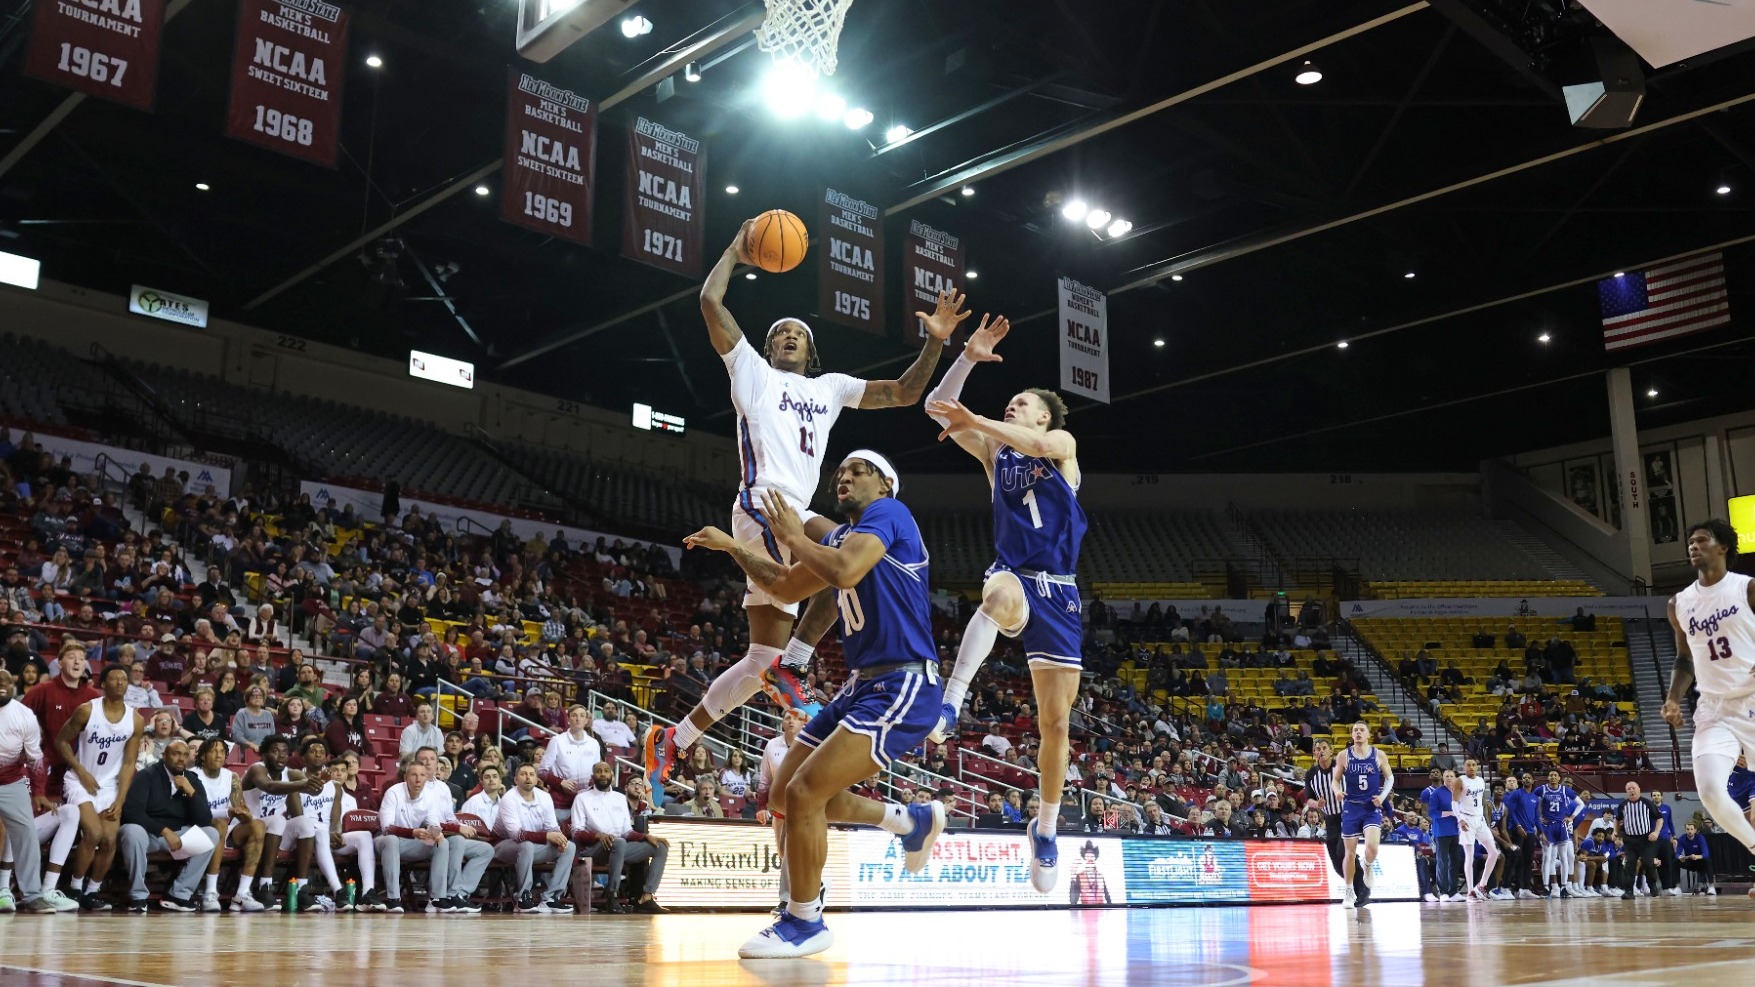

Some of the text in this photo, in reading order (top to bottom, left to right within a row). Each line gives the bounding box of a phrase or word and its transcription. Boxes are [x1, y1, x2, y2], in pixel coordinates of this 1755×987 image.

[57, 1, 141, 38] TOURNAMENT
[72, 0, 142, 23] AA
[279, 5, 312, 26] MEN'S
[308, 0, 338, 20] STATE
[260, 10, 331, 44] BASKETBALL
[58, 42, 128, 87] 1967
[253, 37, 327, 86] NCAA
[248, 65, 329, 101] SWEET SIXTEEN
[521, 75, 589, 112] NEW MEXICO STATE
[525, 104, 583, 133] BASKETBALL
[540, 99, 567, 117] MEN'S
[253, 105, 313, 147] 1968
[652, 122, 677, 144] MEXICO
[675, 132, 698, 153] STATE
[521, 129, 581, 171] NCAA
[641, 146, 693, 174] BASKETBALL
[655, 140, 679, 158] MEN'S
[518, 155, 585, 185] SWEET SIXTEEN
[638, 169, 692, 210] NCAA
[524, 191, 573, 228] 1969
[638, 195, 692, 222] TOURNAMENT
[841, 209, 862, 225] MEN'S
[831, 215, 874, 238] BASKETBALL
[643, 228, 683, 263] 1971
[830, 237, 875, 272] NCAA
[915, 244, 955, 268] BASKETBALL
[925, 240, 944, 254] MEN'S
[830, 261, 874, 283] TOURNAMENT
[914, 266, 954, 297] NCAA
[834, 290, 871, 321] 1975
[1067, 300, 1100, 318] BASKETBALL
[277, 336, 306, 352] 222
[1067, 319, 1100, 347] NCAA
[1068, 340, 1100, 357] TOURNAMENT
[1072, 366, 1098, 391] 1987
[558, 400, 580, 414] 221
[779, 391, 828, 422] Aggies
[1001, 458, 1054, 492] UTA
[1630, 471, 1639, 509] SOUTH
[1021, 488, 1043, 529] 1
[1689, 605, 1739, 637] Aggies
[1707, 636, 1733, 662] 13
[87, 731, 128, 749] Aggies
[97, 751, 108, 765] 0
[733, 786, 745, 795] 22
[1358, 774, 1369, 791] 5
[304, 796, 333, 810] Aggies
[1473, 798, 1478, 807] 3
[1549, 801, 1560, 812] 21
[1588, 802, 1609, 810] Aggies
[317, 811, 324, 822] 1
[679, 841, 782, 873] Edward Jo
[932, 840, 1024, 866] RSTLIGHT,
[680, 878, 721, 889] MAKING
[725, 878, 757, 889] SENSE
[858, 863, 894, 882] IT'S
[938, 864, 999, 883] ABOUT
[1003, 865, 1032, 883] TEA
